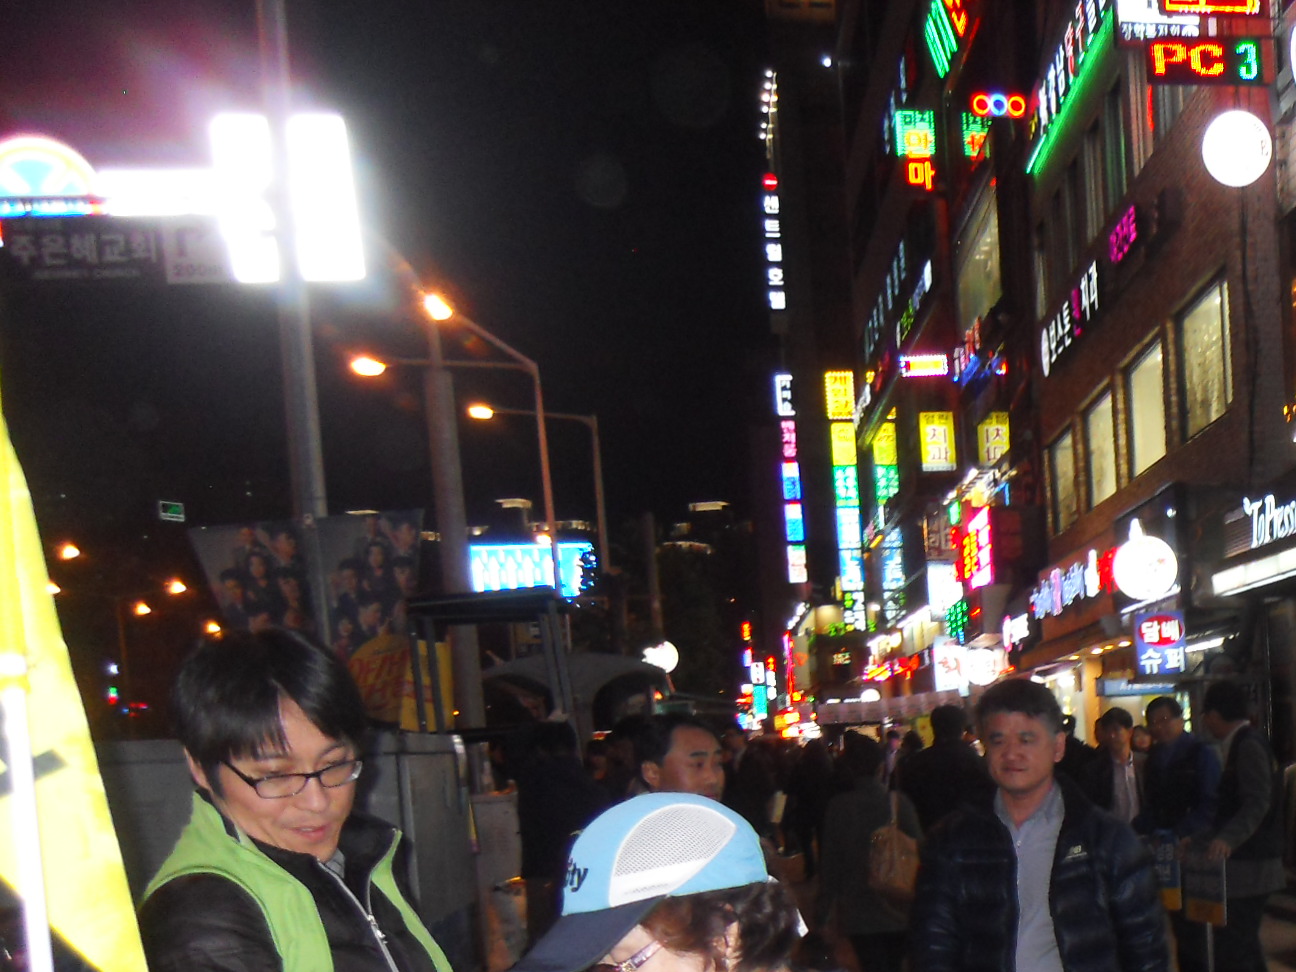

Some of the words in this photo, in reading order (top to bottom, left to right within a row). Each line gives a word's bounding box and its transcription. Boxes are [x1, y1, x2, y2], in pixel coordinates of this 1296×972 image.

[1152, 43, 1225, 76] PC
[1141, 618, 1182, 643] 담배
[1140, 647, 1186, 674] 슈퍼
